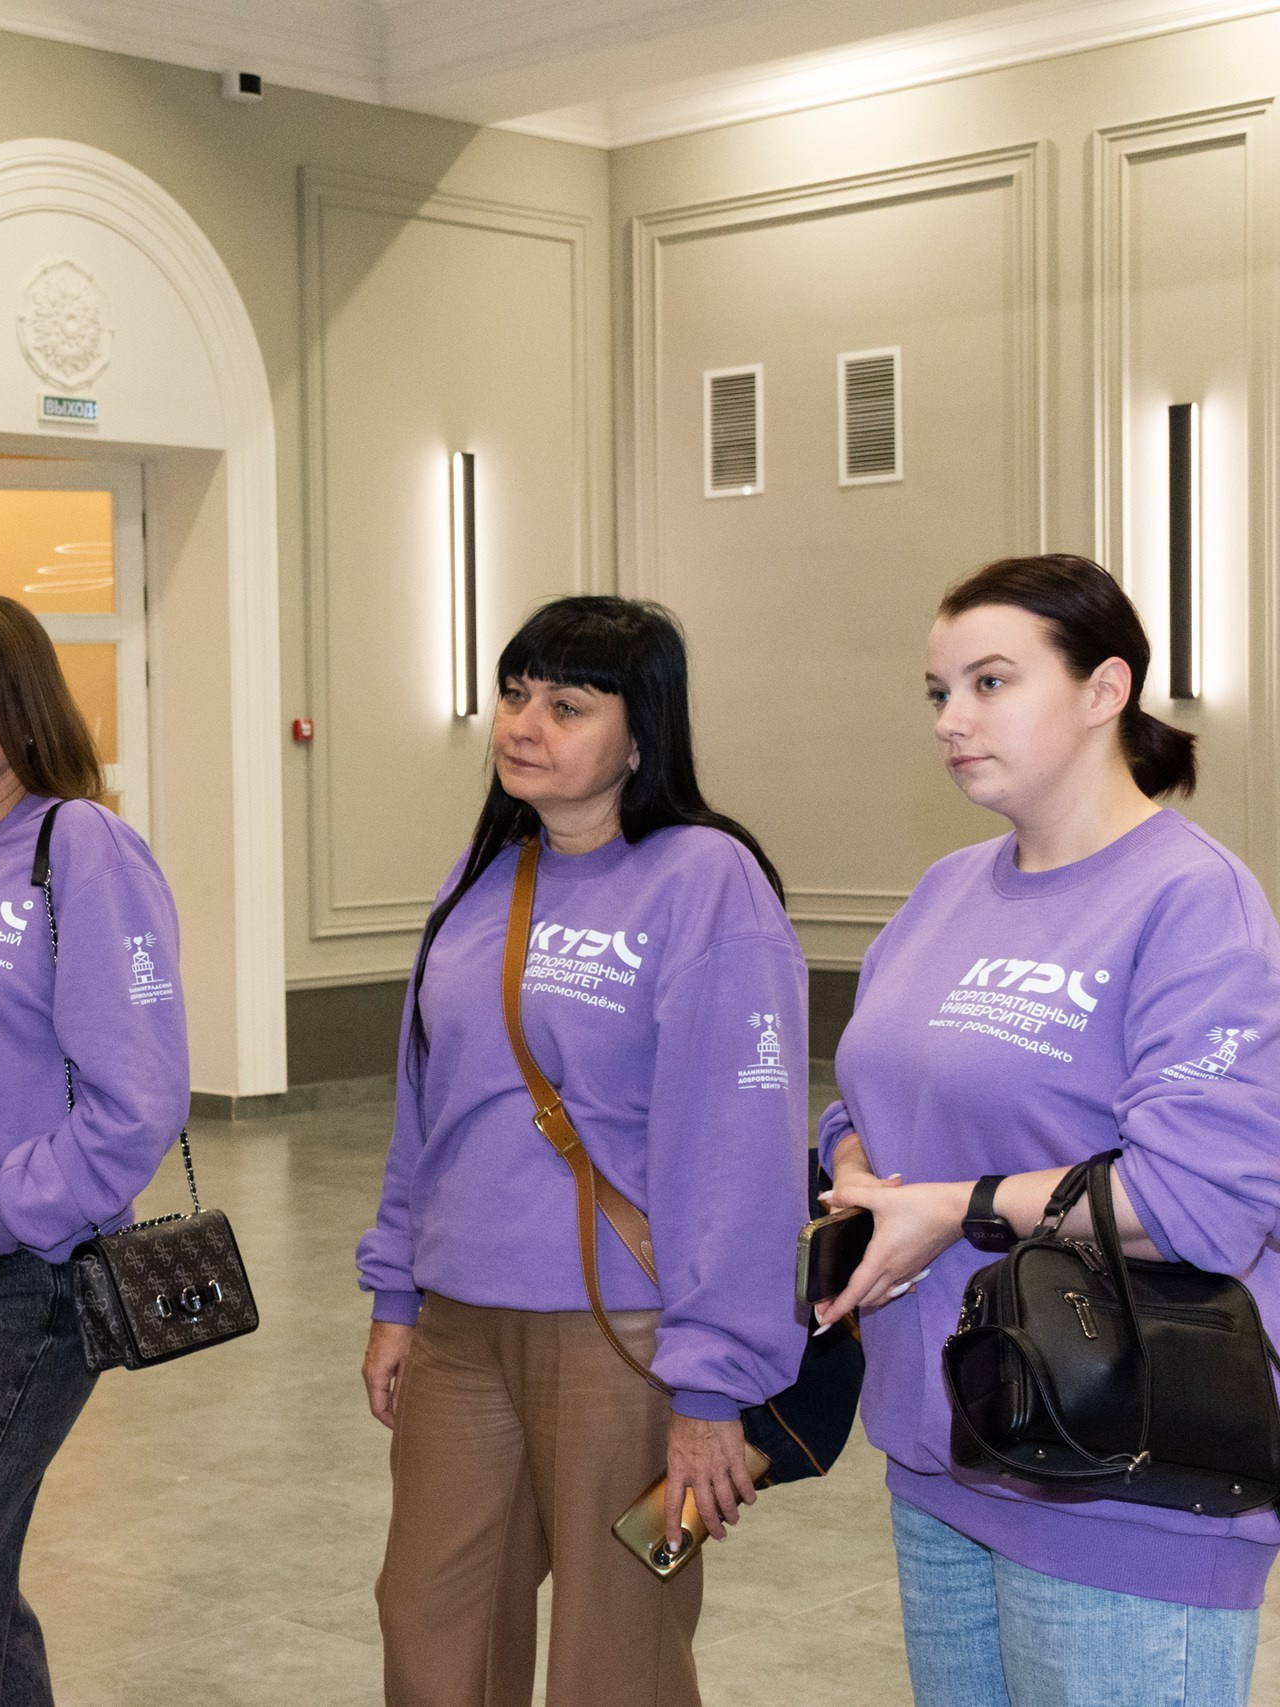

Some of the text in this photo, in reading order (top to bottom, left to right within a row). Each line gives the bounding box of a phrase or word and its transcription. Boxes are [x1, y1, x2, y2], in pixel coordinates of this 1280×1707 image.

[45, 398, 94, 418] ВЫХОД
[524, 965, 603, 990] ИВЕРСИТЕТ
[527, 952, 636, 986] РПОРАТИВНЫЙ
[532, 982, 626, 1014] росмолодёжь
[946, 990, 1088, 1032] КОРПОРАТИВНЫЙ
[939, 1002, 1047, 1034] УНИВЕРСИТЕТ
[928, 1019, 1073, 1063] вместе с росмолодёжь
